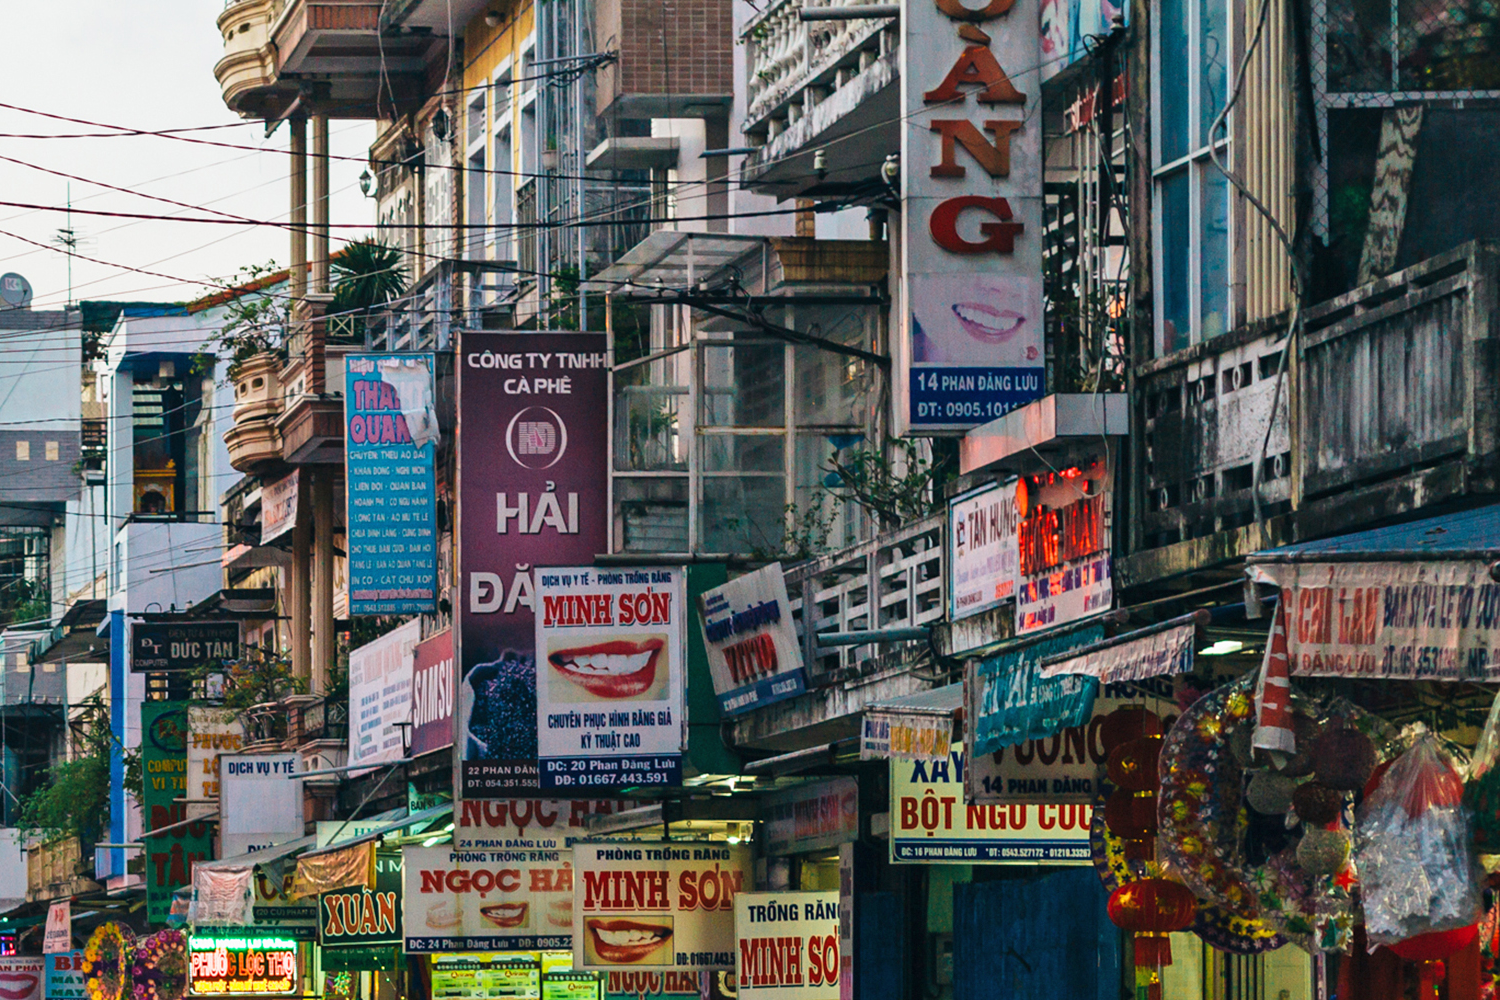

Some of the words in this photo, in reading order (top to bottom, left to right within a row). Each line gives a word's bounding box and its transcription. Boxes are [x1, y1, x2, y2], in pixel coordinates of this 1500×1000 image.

[468, 350, 522, 369] CÔNG
[526, 353, 551, 369] TY
[555, 353, 608, 369] TNHH
[504, 375, 531, 394] CÀ
[534, 375, 571, 394] PHÊ
[917, 373, 938, 392] 14
[942, 375, 975, 391] PHAN
[977, 371, 1012, 392] ĐĂNG
[1015, 372, 1038, 392] LƯU
[917, 403, 942, 417] ĐT:
[496, 480, 582, 535] HẢI
[574, 575, 579, 586] Y
[543, 594, 613, 628] MINH
[619, 587, 672, 626] SƠN
[171, 638, 200, 658] ĐỨC
[205, 638, 233, 658] TÂN
[414, 658, 453, 729] SAMSU
[548, 710, 581, 728] CHUYÊN
[584, 713, 606, 731] PHỤC
[609, 710, 629, 727] HÌNH
[632, 709, 655, 726] RĂNG
[595, 731, 621, 751] THUẬT
[623, 733, 640, 748] CAO
[229, 761, 253, 776] DỊCH
[257, 762, 270, 776] VỤ
[273, 762, 280, 773] Y
[282, 757, 295, 773] TẾ
[468, 767, 479, 775] 22
[482, 767, 513, 775] PHAN
[547, 761, 567, 772] ĐC:
[571, 761, 586, 771] 20
[589, 760, 618, 770] Phan
[621, 759, 650, 771] Đăng
[655, 758, 675, 769] Lưu
[468, 779, 483, 788] ĐT:
[555, 775, 575, 785] DĐ:
[579, 773, 668, 784] 01667.443.591
[982, 776, 1003, 794] 14
[1007, 779, 1047, 794] PHAN
[1053, 776, 1091, 793] ĐĂNG
[900, 789, 956, 837] BỘT
[475, 840, 500, 848] PHAN
[502, 838, 534, 848] ĐĂNG
[536, 840, 557, 848] LƯU
[915, 848, 923, 856] 16
[924, 848, 943, 856] PHAN
[944, 846, 963, 857] ĐĂNG
[449, 851, 486, 862] PHÒNG
[530, 851, 559, 862] RĂNG
[596, 846, 642, 861] PHÒNG
[693, 847, 730, 860] RĂNG
[420, 868, 521, 899] NGỌC
[529, 862, 573, 892] HẢ
[582, 870, 671, 911] MINH
[678, 862, 744, 911] SƠN
[805, 899, 840, 920] RĂN
[410, 939, 426, 949] ĐC:
[428, 939, 440, 949] 24
[442, 940, 464, 949] Phan
[467, 939, 489, 950] Đăng
[537, 938, 573, 948] 0905.22
[267, 952, 294, 981] THỌ
[690, 952, 735, 966] 01667.443.5
[740, 936, 804, 989] MINH
[808, 925, 840, 986] SƠ
